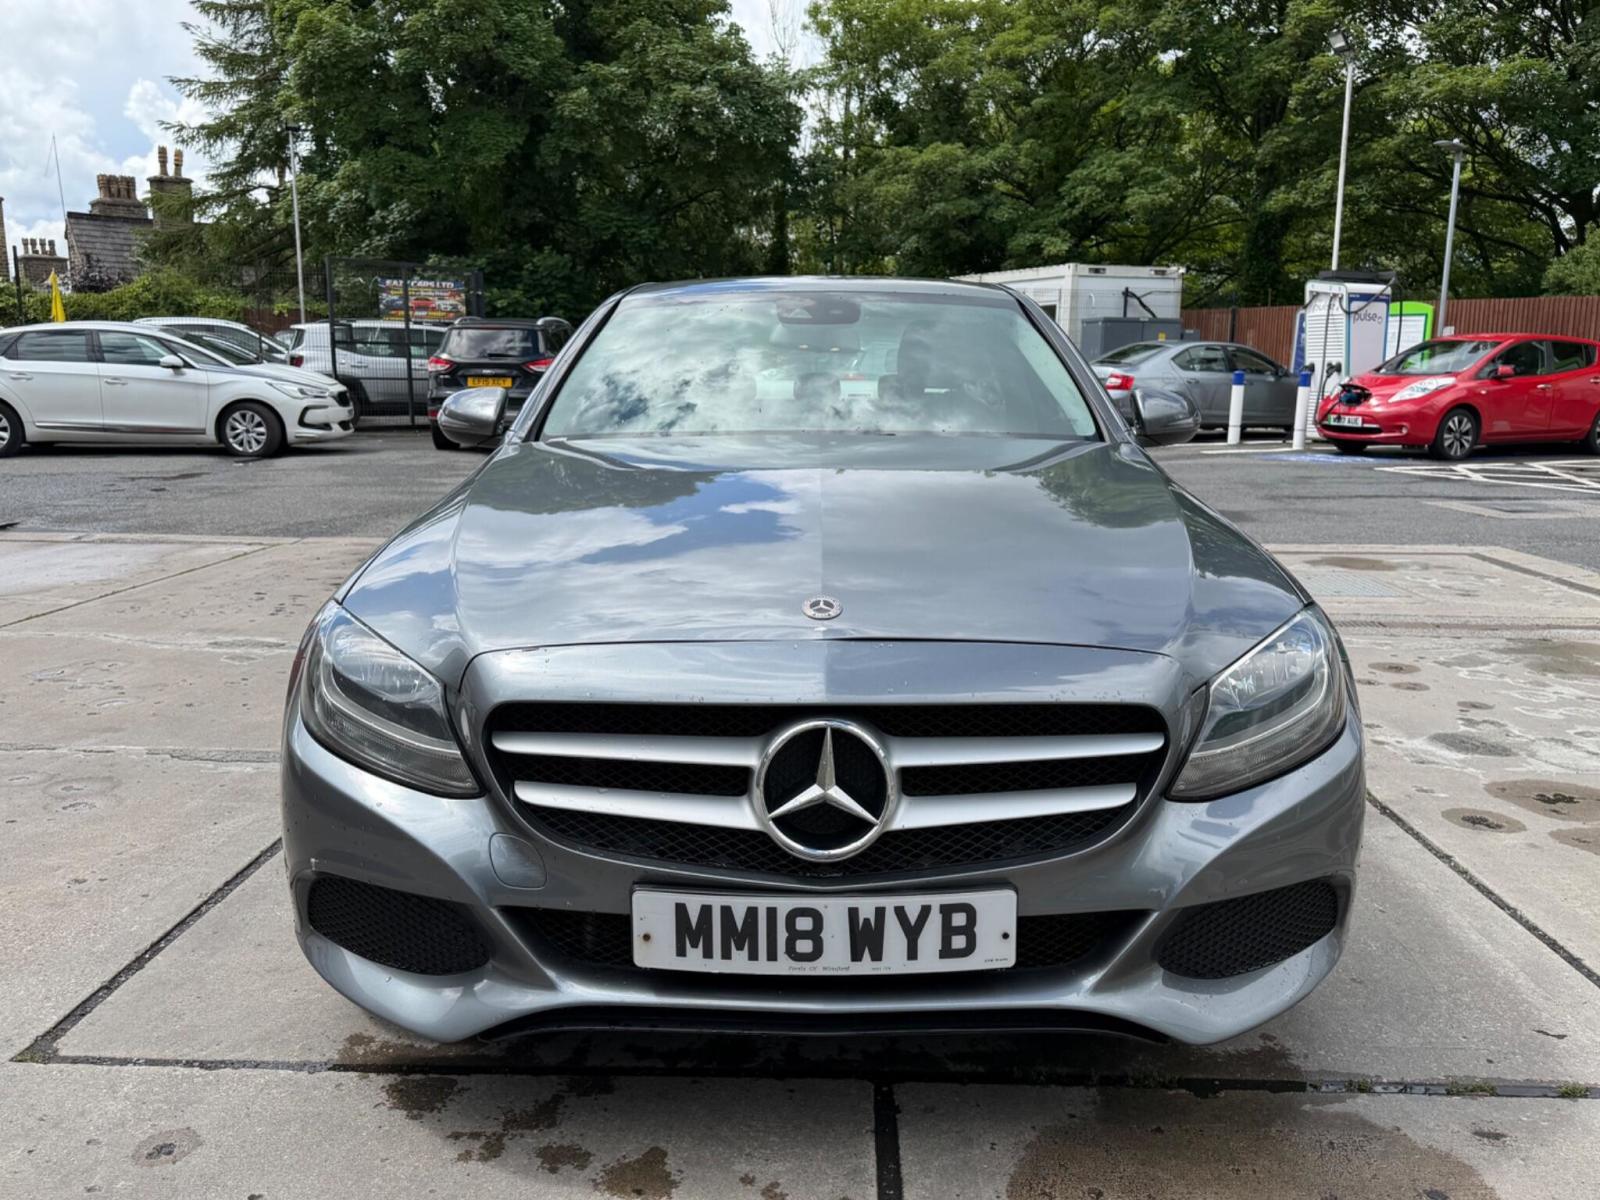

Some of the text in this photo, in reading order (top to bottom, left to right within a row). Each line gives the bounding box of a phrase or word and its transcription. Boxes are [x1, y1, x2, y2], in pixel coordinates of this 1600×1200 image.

[436, 281, 455, 289] LTD
[1353, 308, 1377, 324] pulse
[675, 902, 976, 962] MM18 WYB
